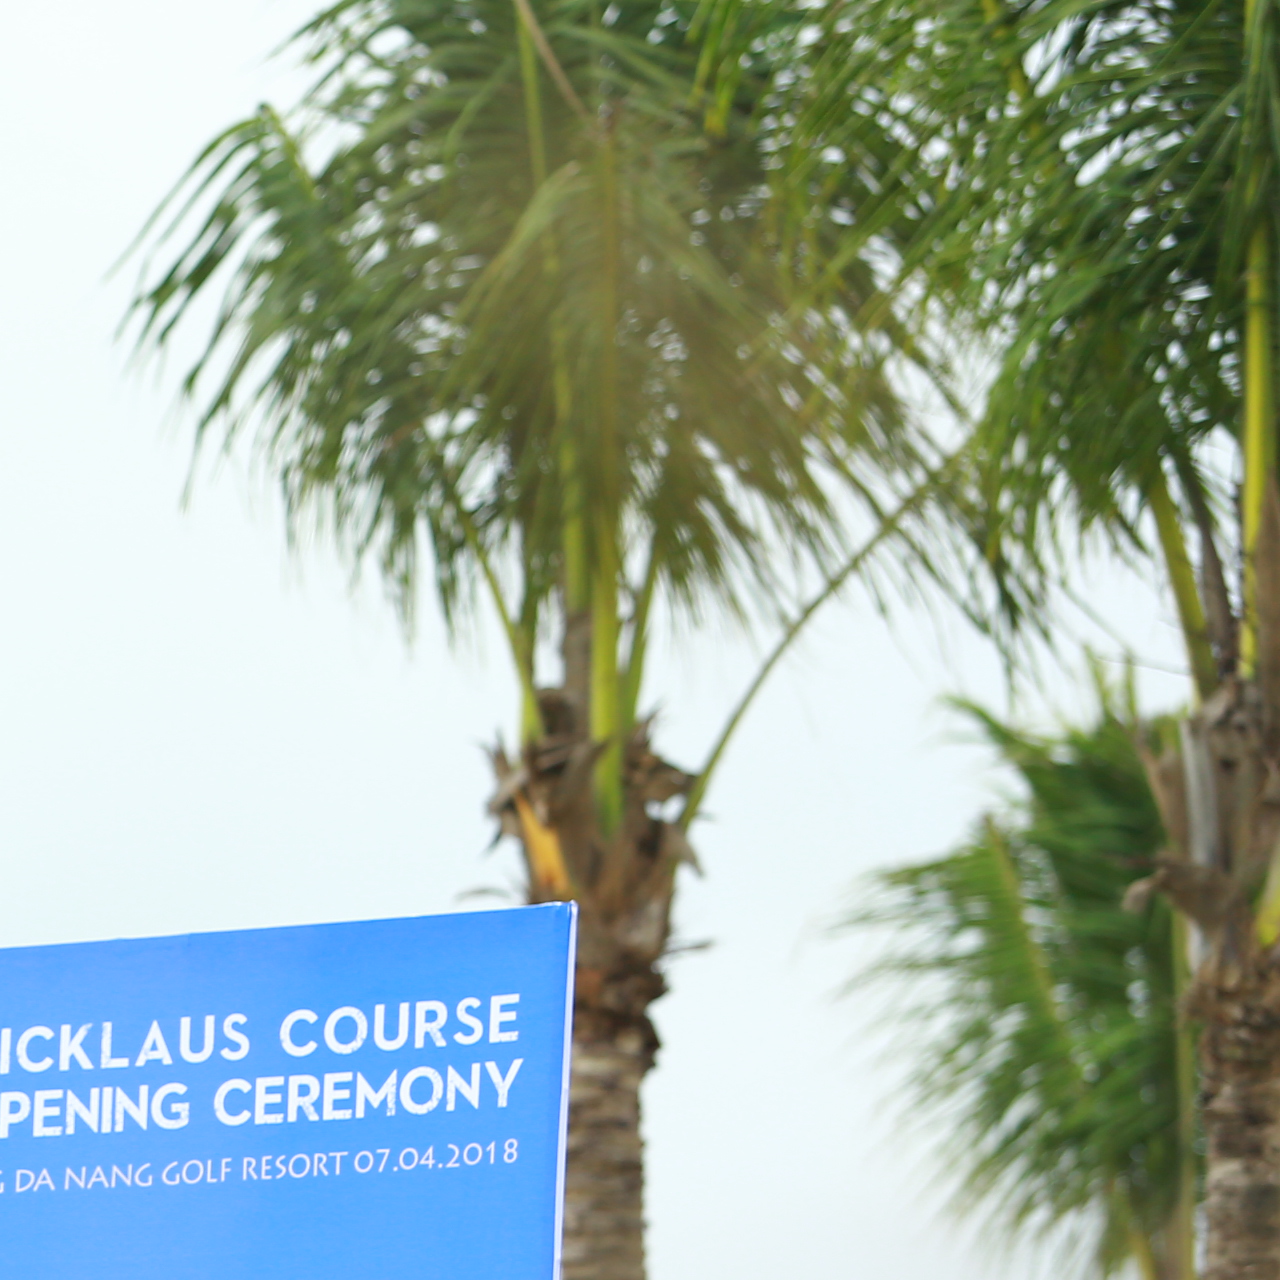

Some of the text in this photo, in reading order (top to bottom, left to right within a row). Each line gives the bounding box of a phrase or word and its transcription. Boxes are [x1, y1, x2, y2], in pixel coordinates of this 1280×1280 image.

[279, 993, 521, 1057] COURSE
[213, 1058, 524, 1126] CEREMONY
[15, 1168, 56, 1193] DA
[63, 1162, 153, 1190] NANG
[161, 1157, 233, 1186] GOLF
[242, 1151, 349, 1181] RESORT
[353, 1137, 519, 1173] 07.04.2018
